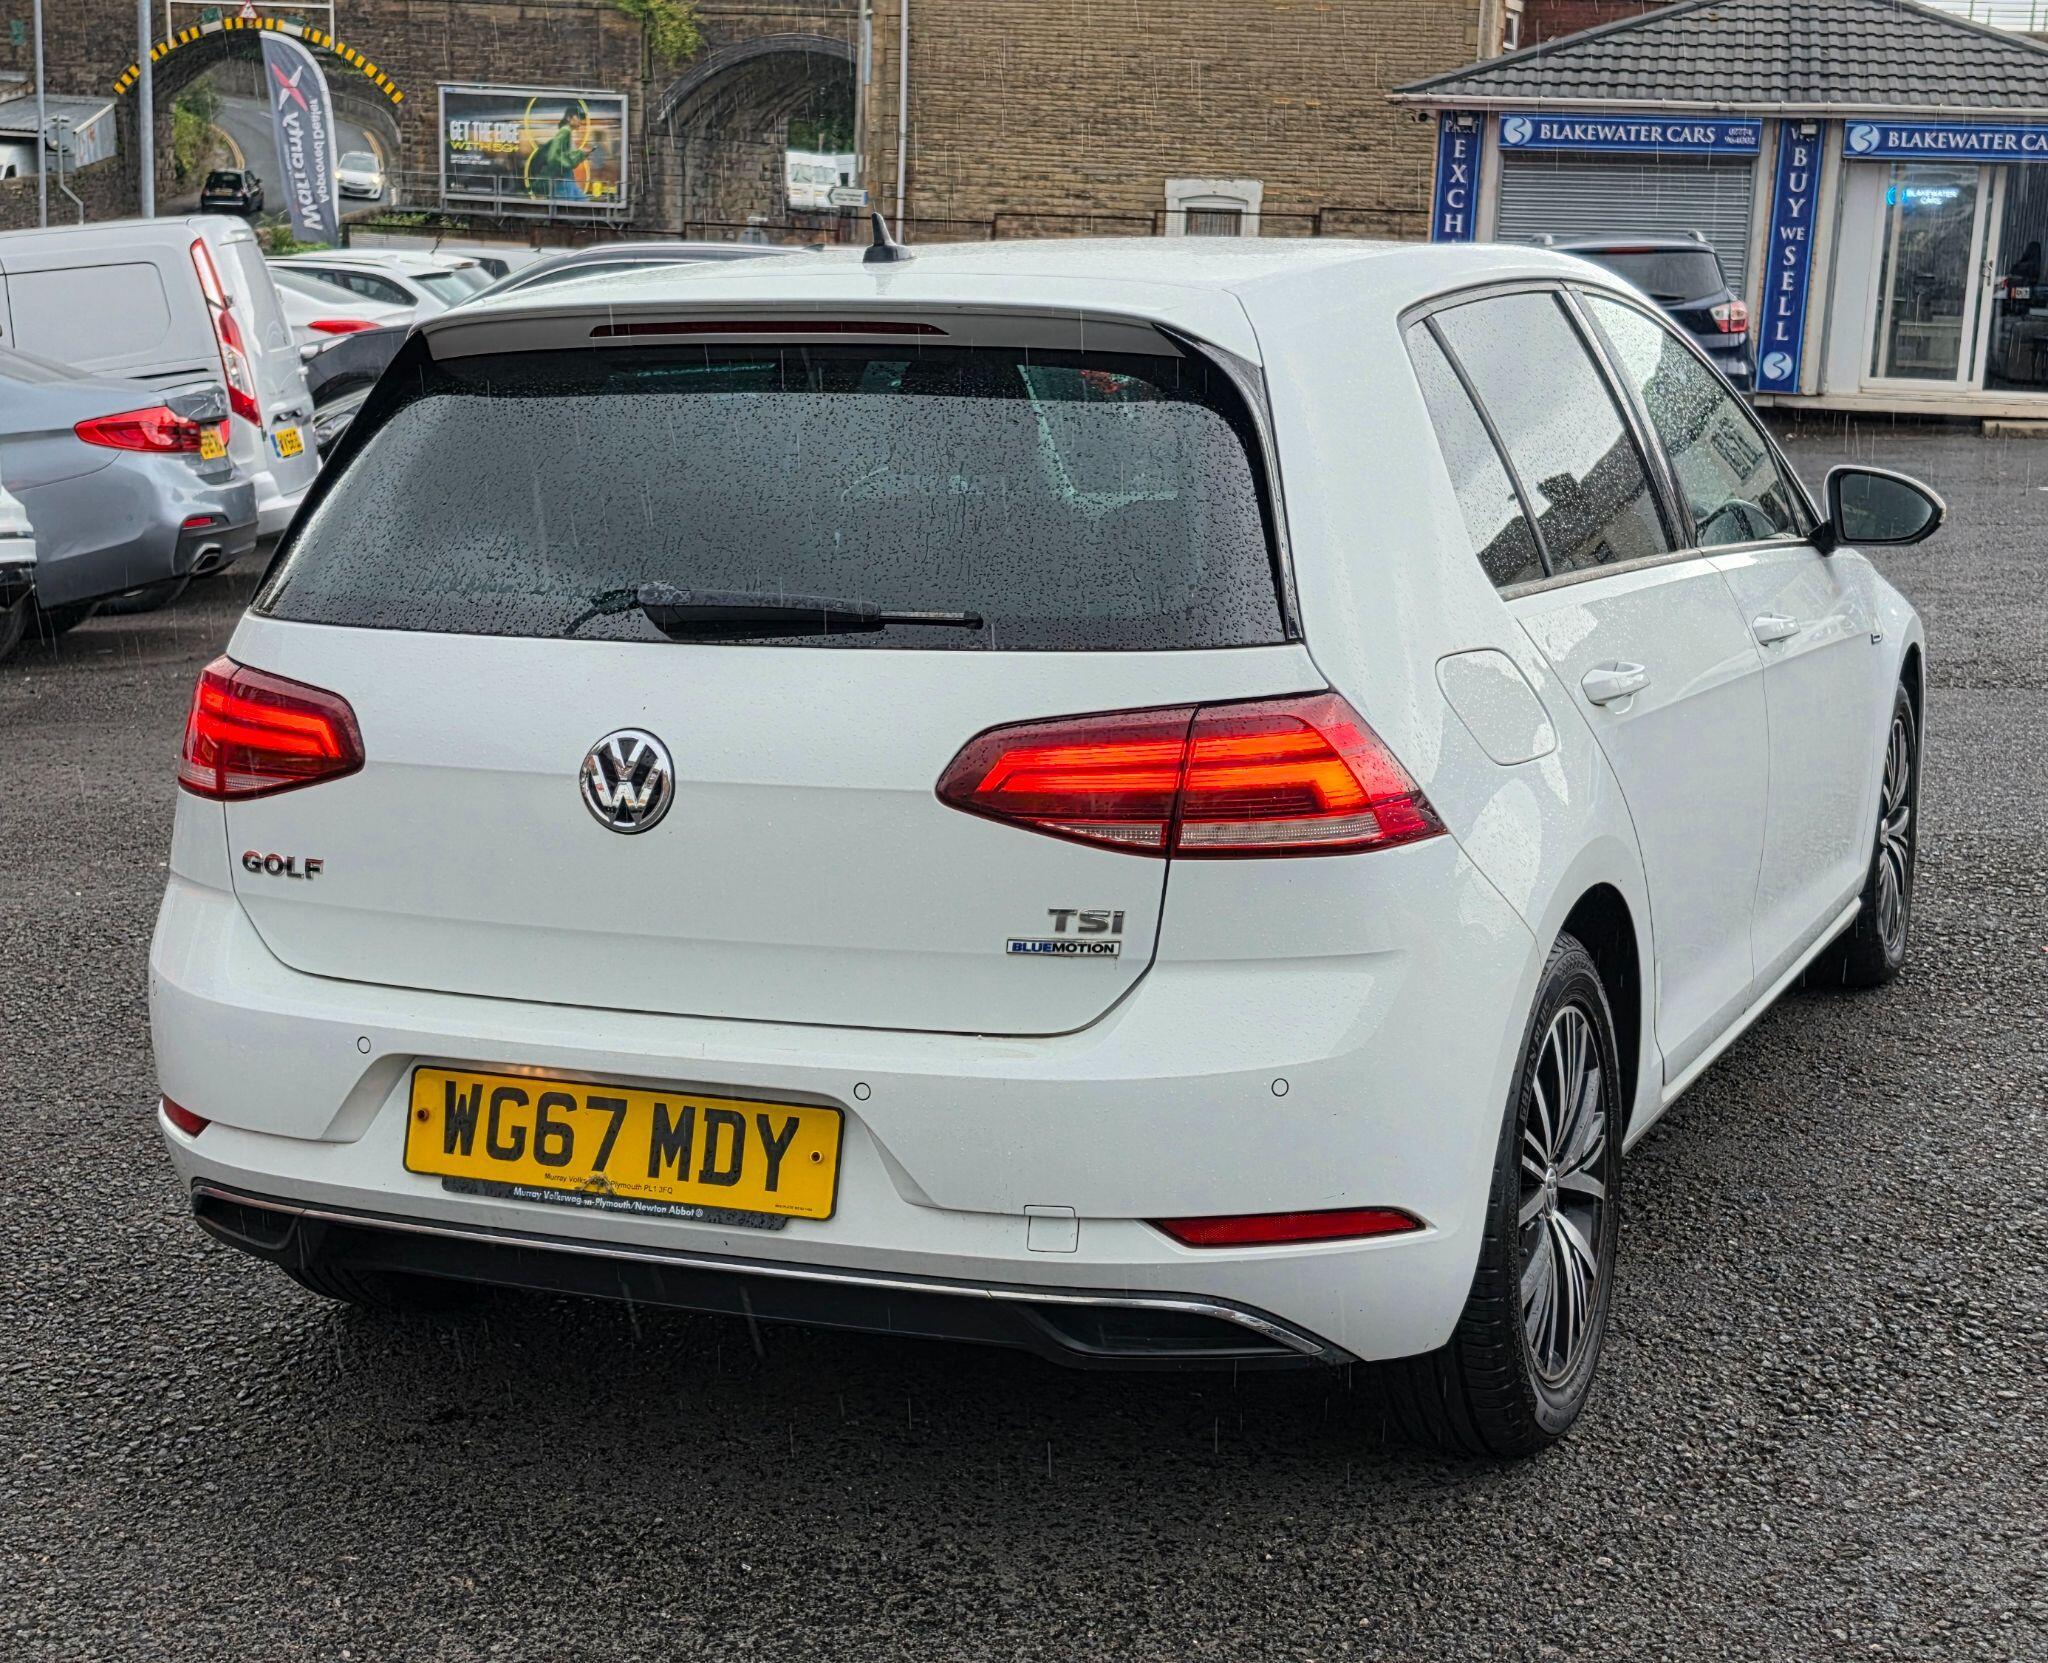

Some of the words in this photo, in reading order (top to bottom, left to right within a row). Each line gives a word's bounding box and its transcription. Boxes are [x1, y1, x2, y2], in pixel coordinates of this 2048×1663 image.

[450, 120, 470, 141] GET
[1445, 119, 1480, 134] PAT
[1540, 123, 1664, 143] BLAKEWATER
[1666, 125, 1716, 144] CARS
[1888, 131, 2019, 151] BLAKEWATER
[1444, 139, 1467, 243] EXCH
[1788, 147, 1808, 218] BUY
[1780, 226, 1806, 241] WE
[1775, 246, 1796, 341] SELL
[241, 850, 325, 880] GOLF
[1012, 942, 1115, 954] BLUEMOTION
[443, 1080, 627, 1171] WG67
[647, 1102, 800, 1192] MDY
[544, 1172, 566, 1183] Murray
[610, 1180, 642, 1192] Plymouth
[513, 1186, 542, 1201] Murray
[668, 1205, 695, 1217] Abbot
